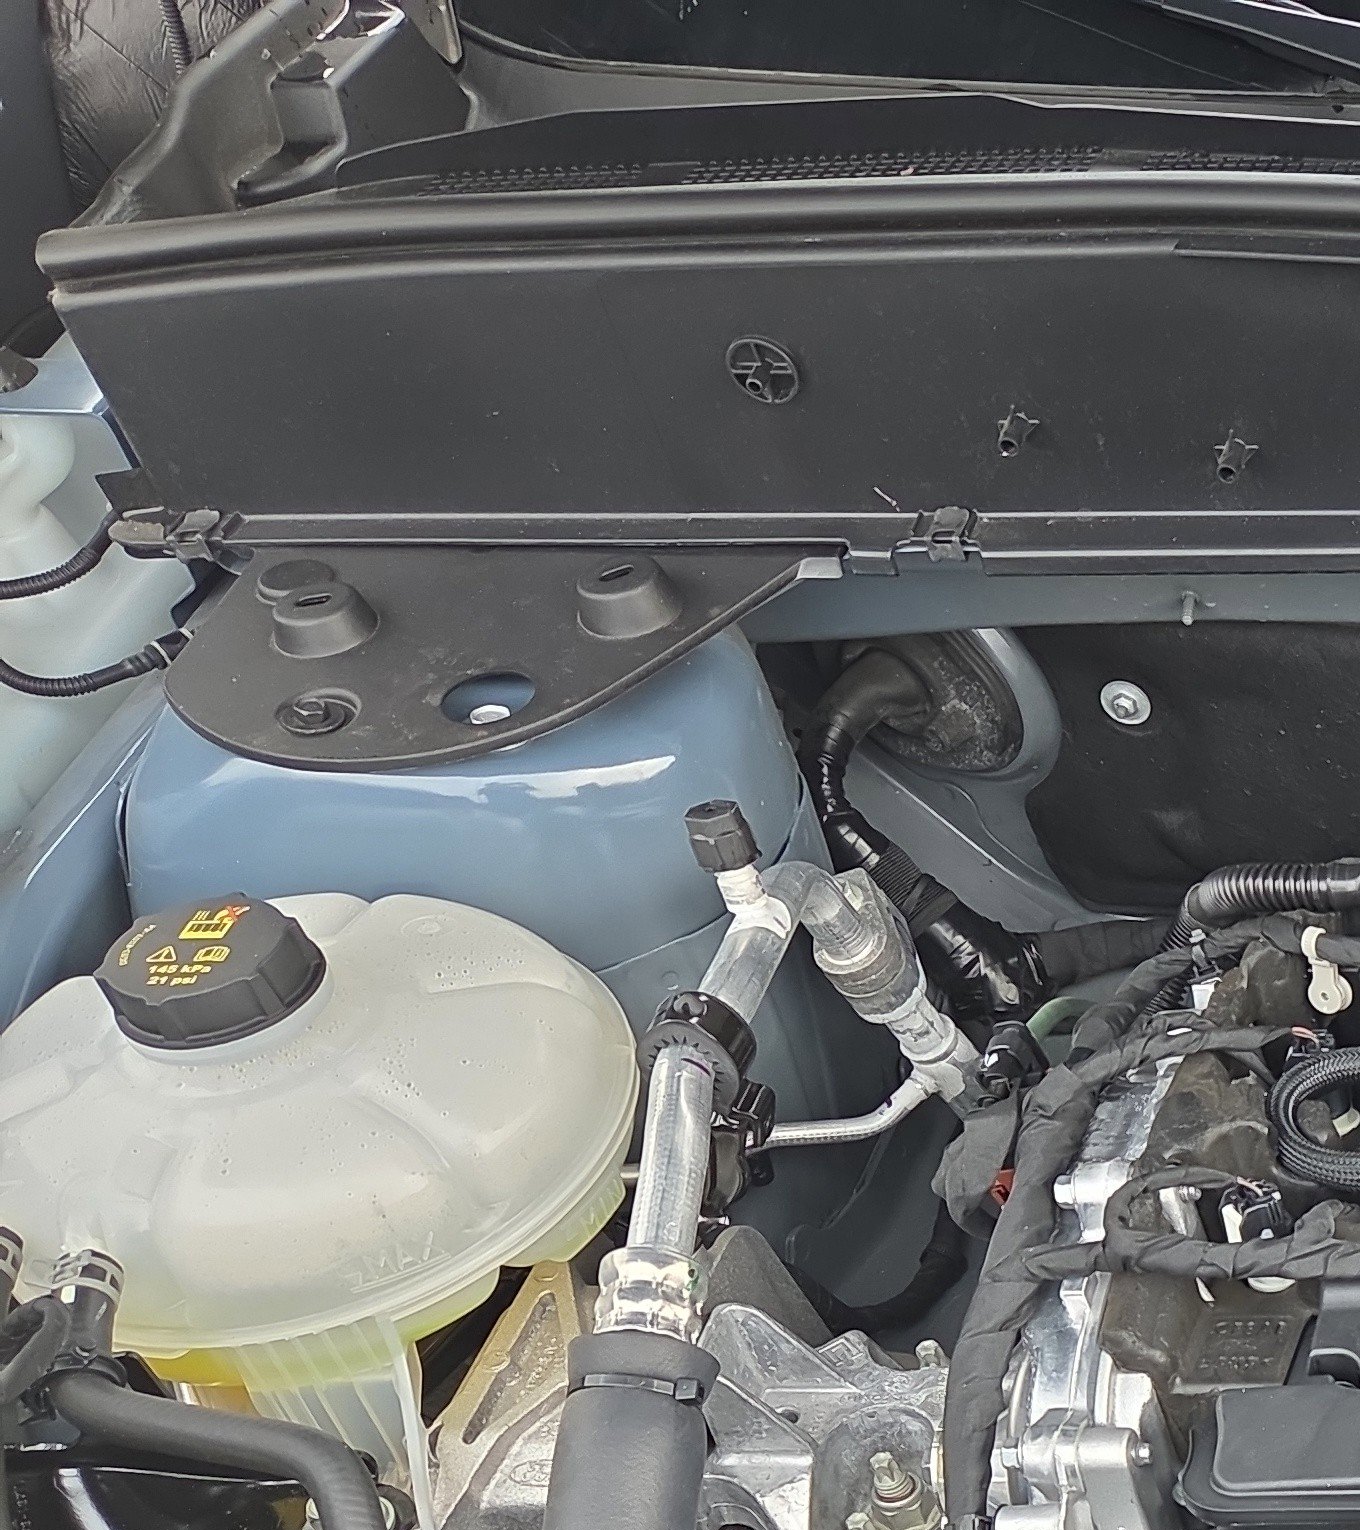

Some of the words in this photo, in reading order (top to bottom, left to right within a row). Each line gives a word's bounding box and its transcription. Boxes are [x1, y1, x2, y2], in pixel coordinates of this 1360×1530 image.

[149, 964, 178, 974] 145
[180, 965, 212, 974] kPa
[146, 976, 168, 985] 21
[169, 975, 198, 987] psi
